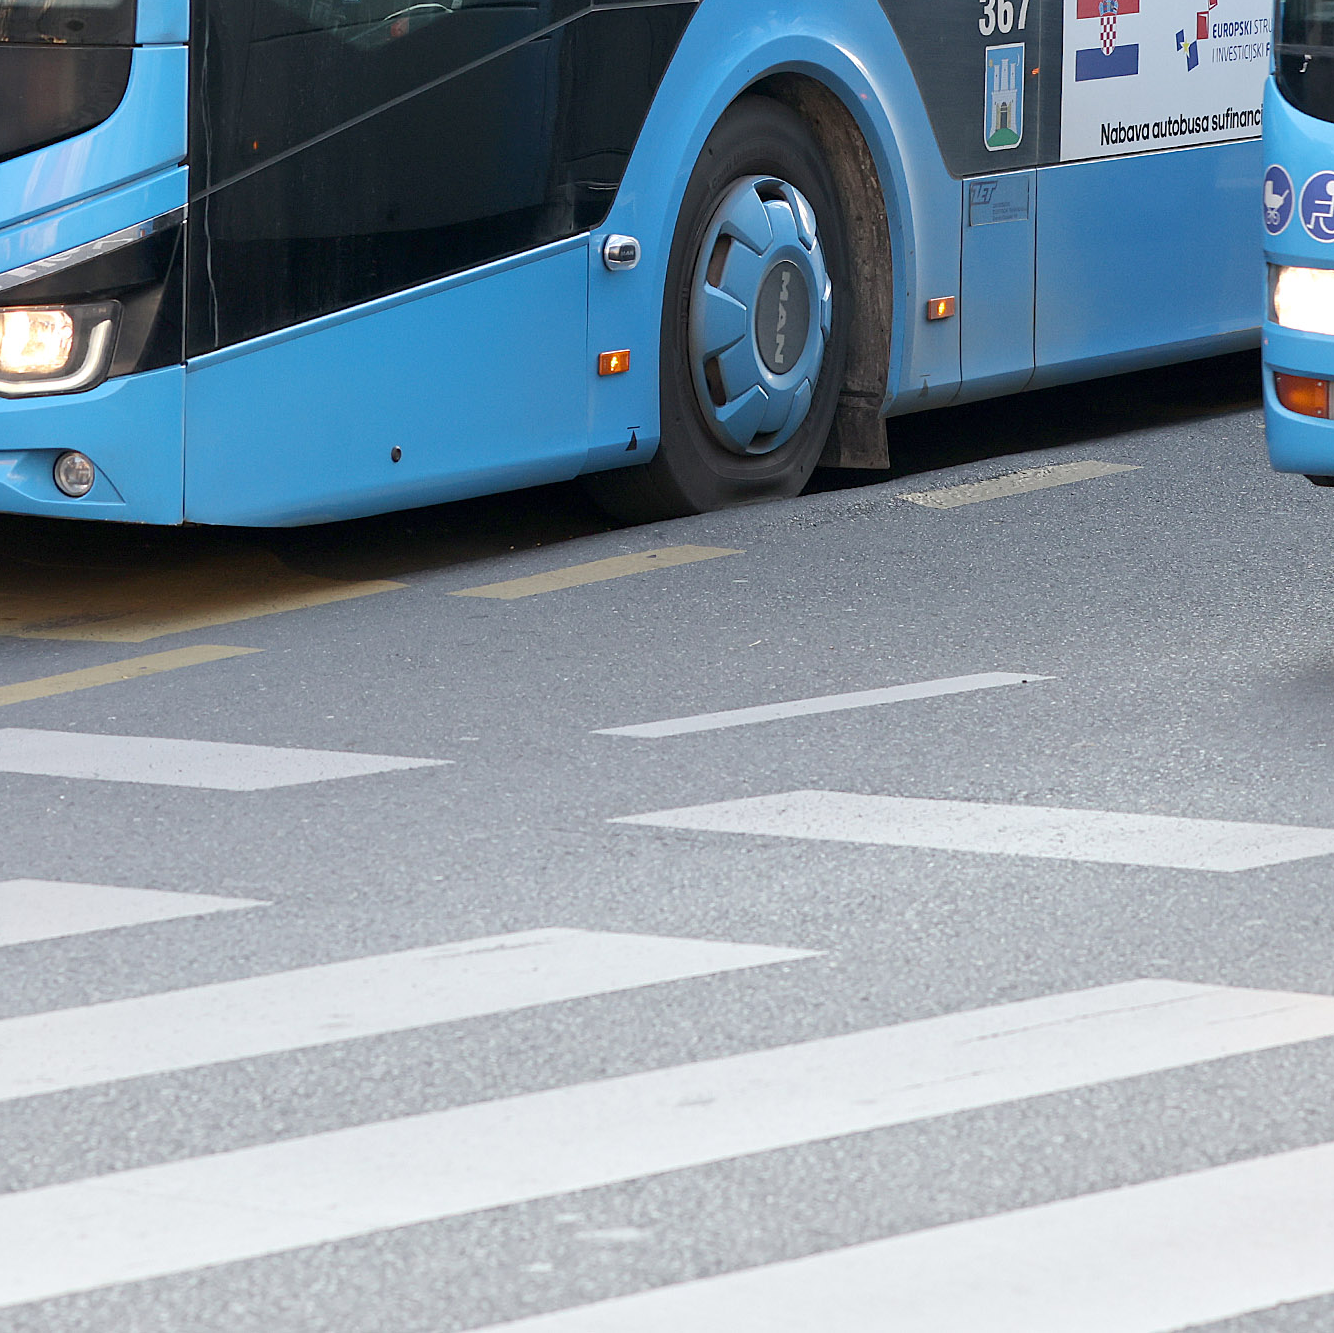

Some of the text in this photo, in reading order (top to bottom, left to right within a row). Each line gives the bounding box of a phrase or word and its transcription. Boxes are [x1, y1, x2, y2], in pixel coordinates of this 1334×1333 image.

[1212, 20, 1253, 39] EUROPSKI
[1216, 42, 1265, 63] INVESTICIJSKI
[1100, 121, 1150, 146] Nabava
[1152, 113, 1210, 139] autobusa
[774, 270, 791, 364] MAN
